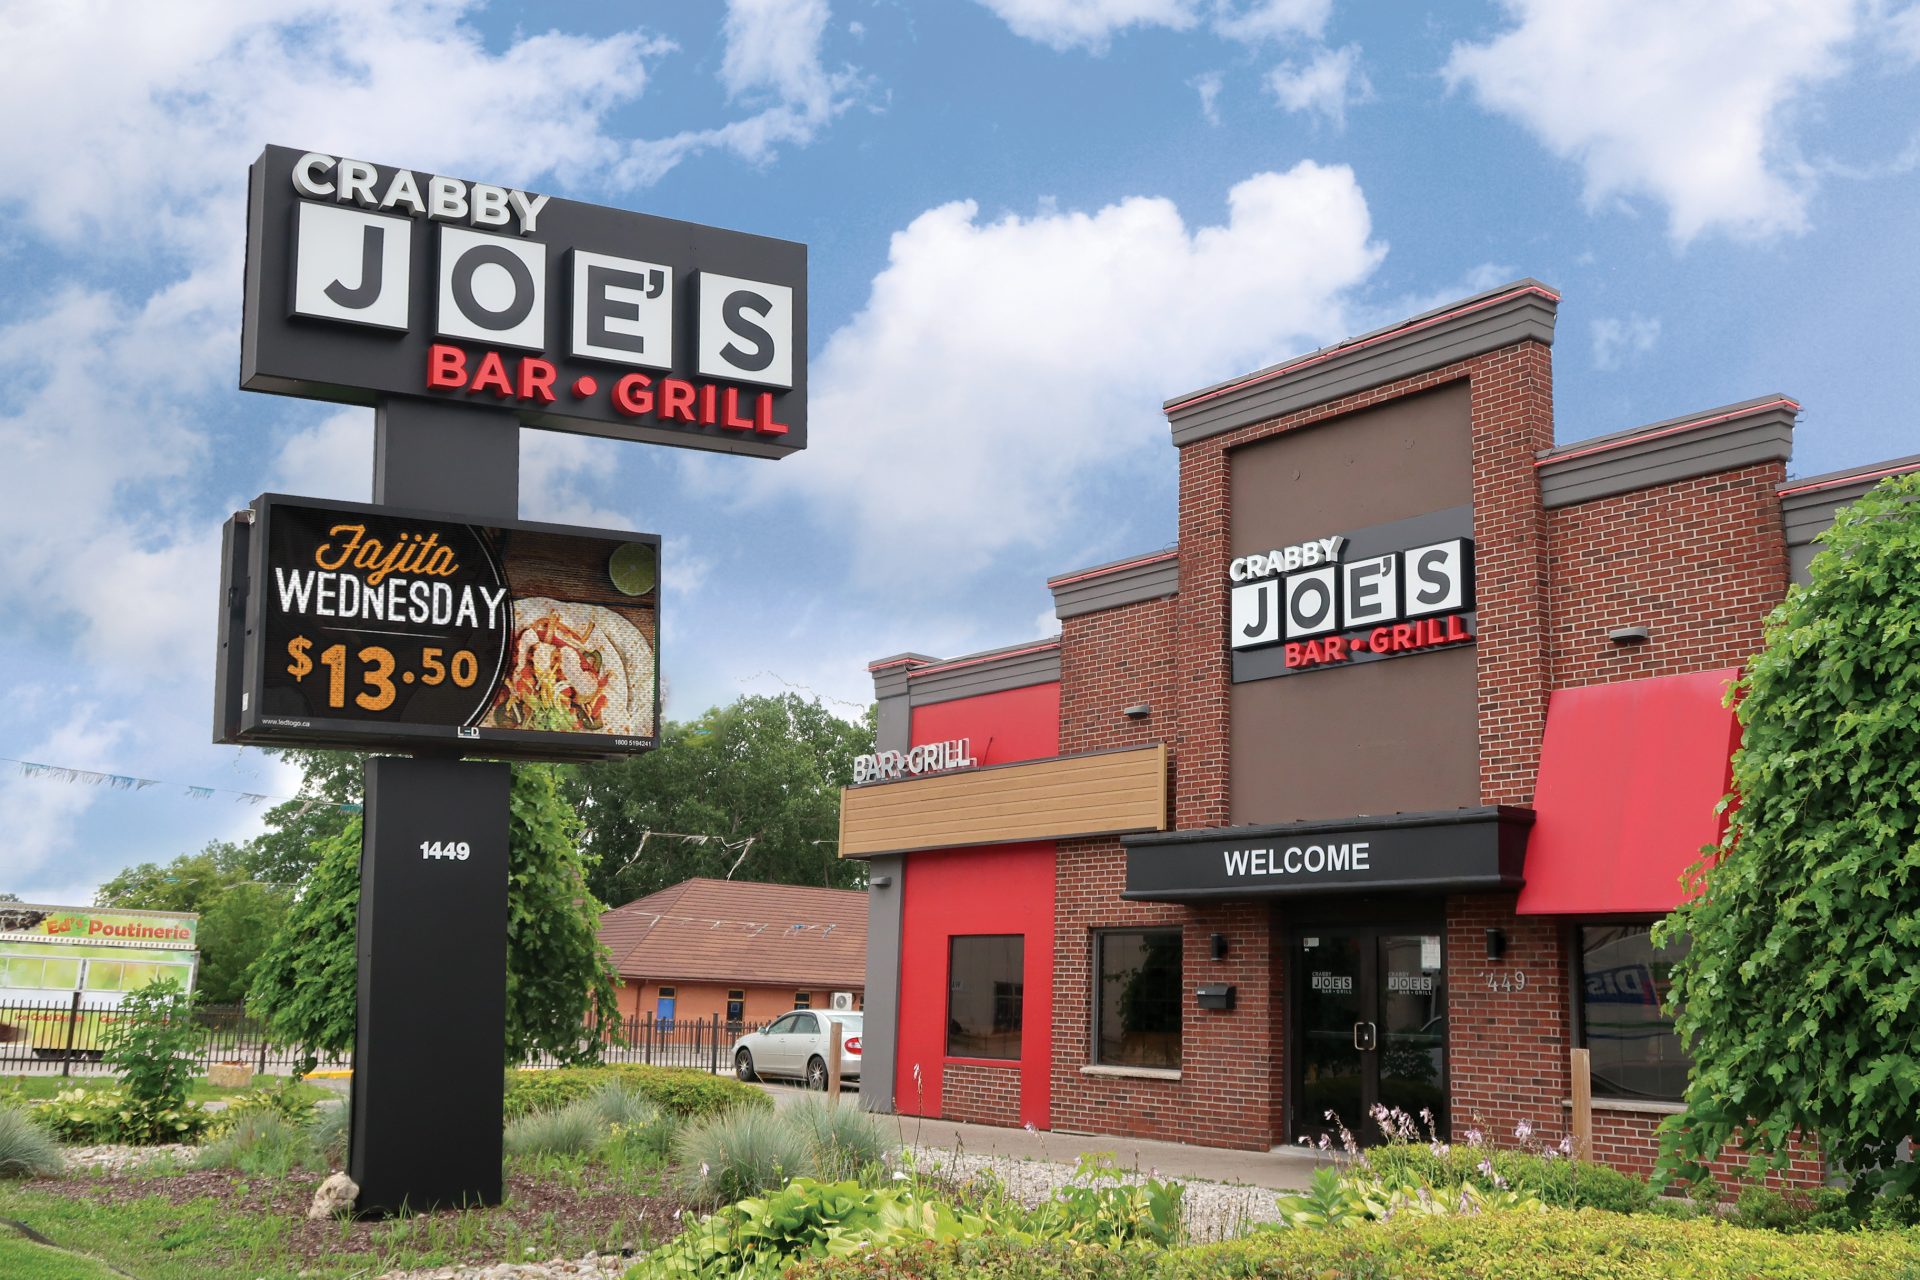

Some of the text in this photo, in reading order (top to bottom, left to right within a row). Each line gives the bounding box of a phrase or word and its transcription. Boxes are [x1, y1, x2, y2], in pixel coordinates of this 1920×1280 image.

[292, 152, 550, 235] CRABBY
[323, 225, 775, 371] JOE'S
[427, 343, 788, 435] BAR GRILL
[315, 524, 459, 586] Fajita
[1229, 535, 1345, 582] CRABBY
[275, 567, 507, 629] WEDNESDAY
[1242, 549, 1451, 638] JOE'S
[1284, 615, 1471, 669] BAR GRILL
[287, 635, 478, 711] $13.50
[261, 718, 311, 728] www.ledtogo.ca
[854, 738, 973, 783] BAR GRILL
[420, 841, 470, 860] 1449
[1224, 843, 1370, 876] WELCOME
[47, 916, 191, 940] Ed's Poutinerie
[14, 1012, 29, 1021] Ice
[30, 1013, 53, 1021] Cold
